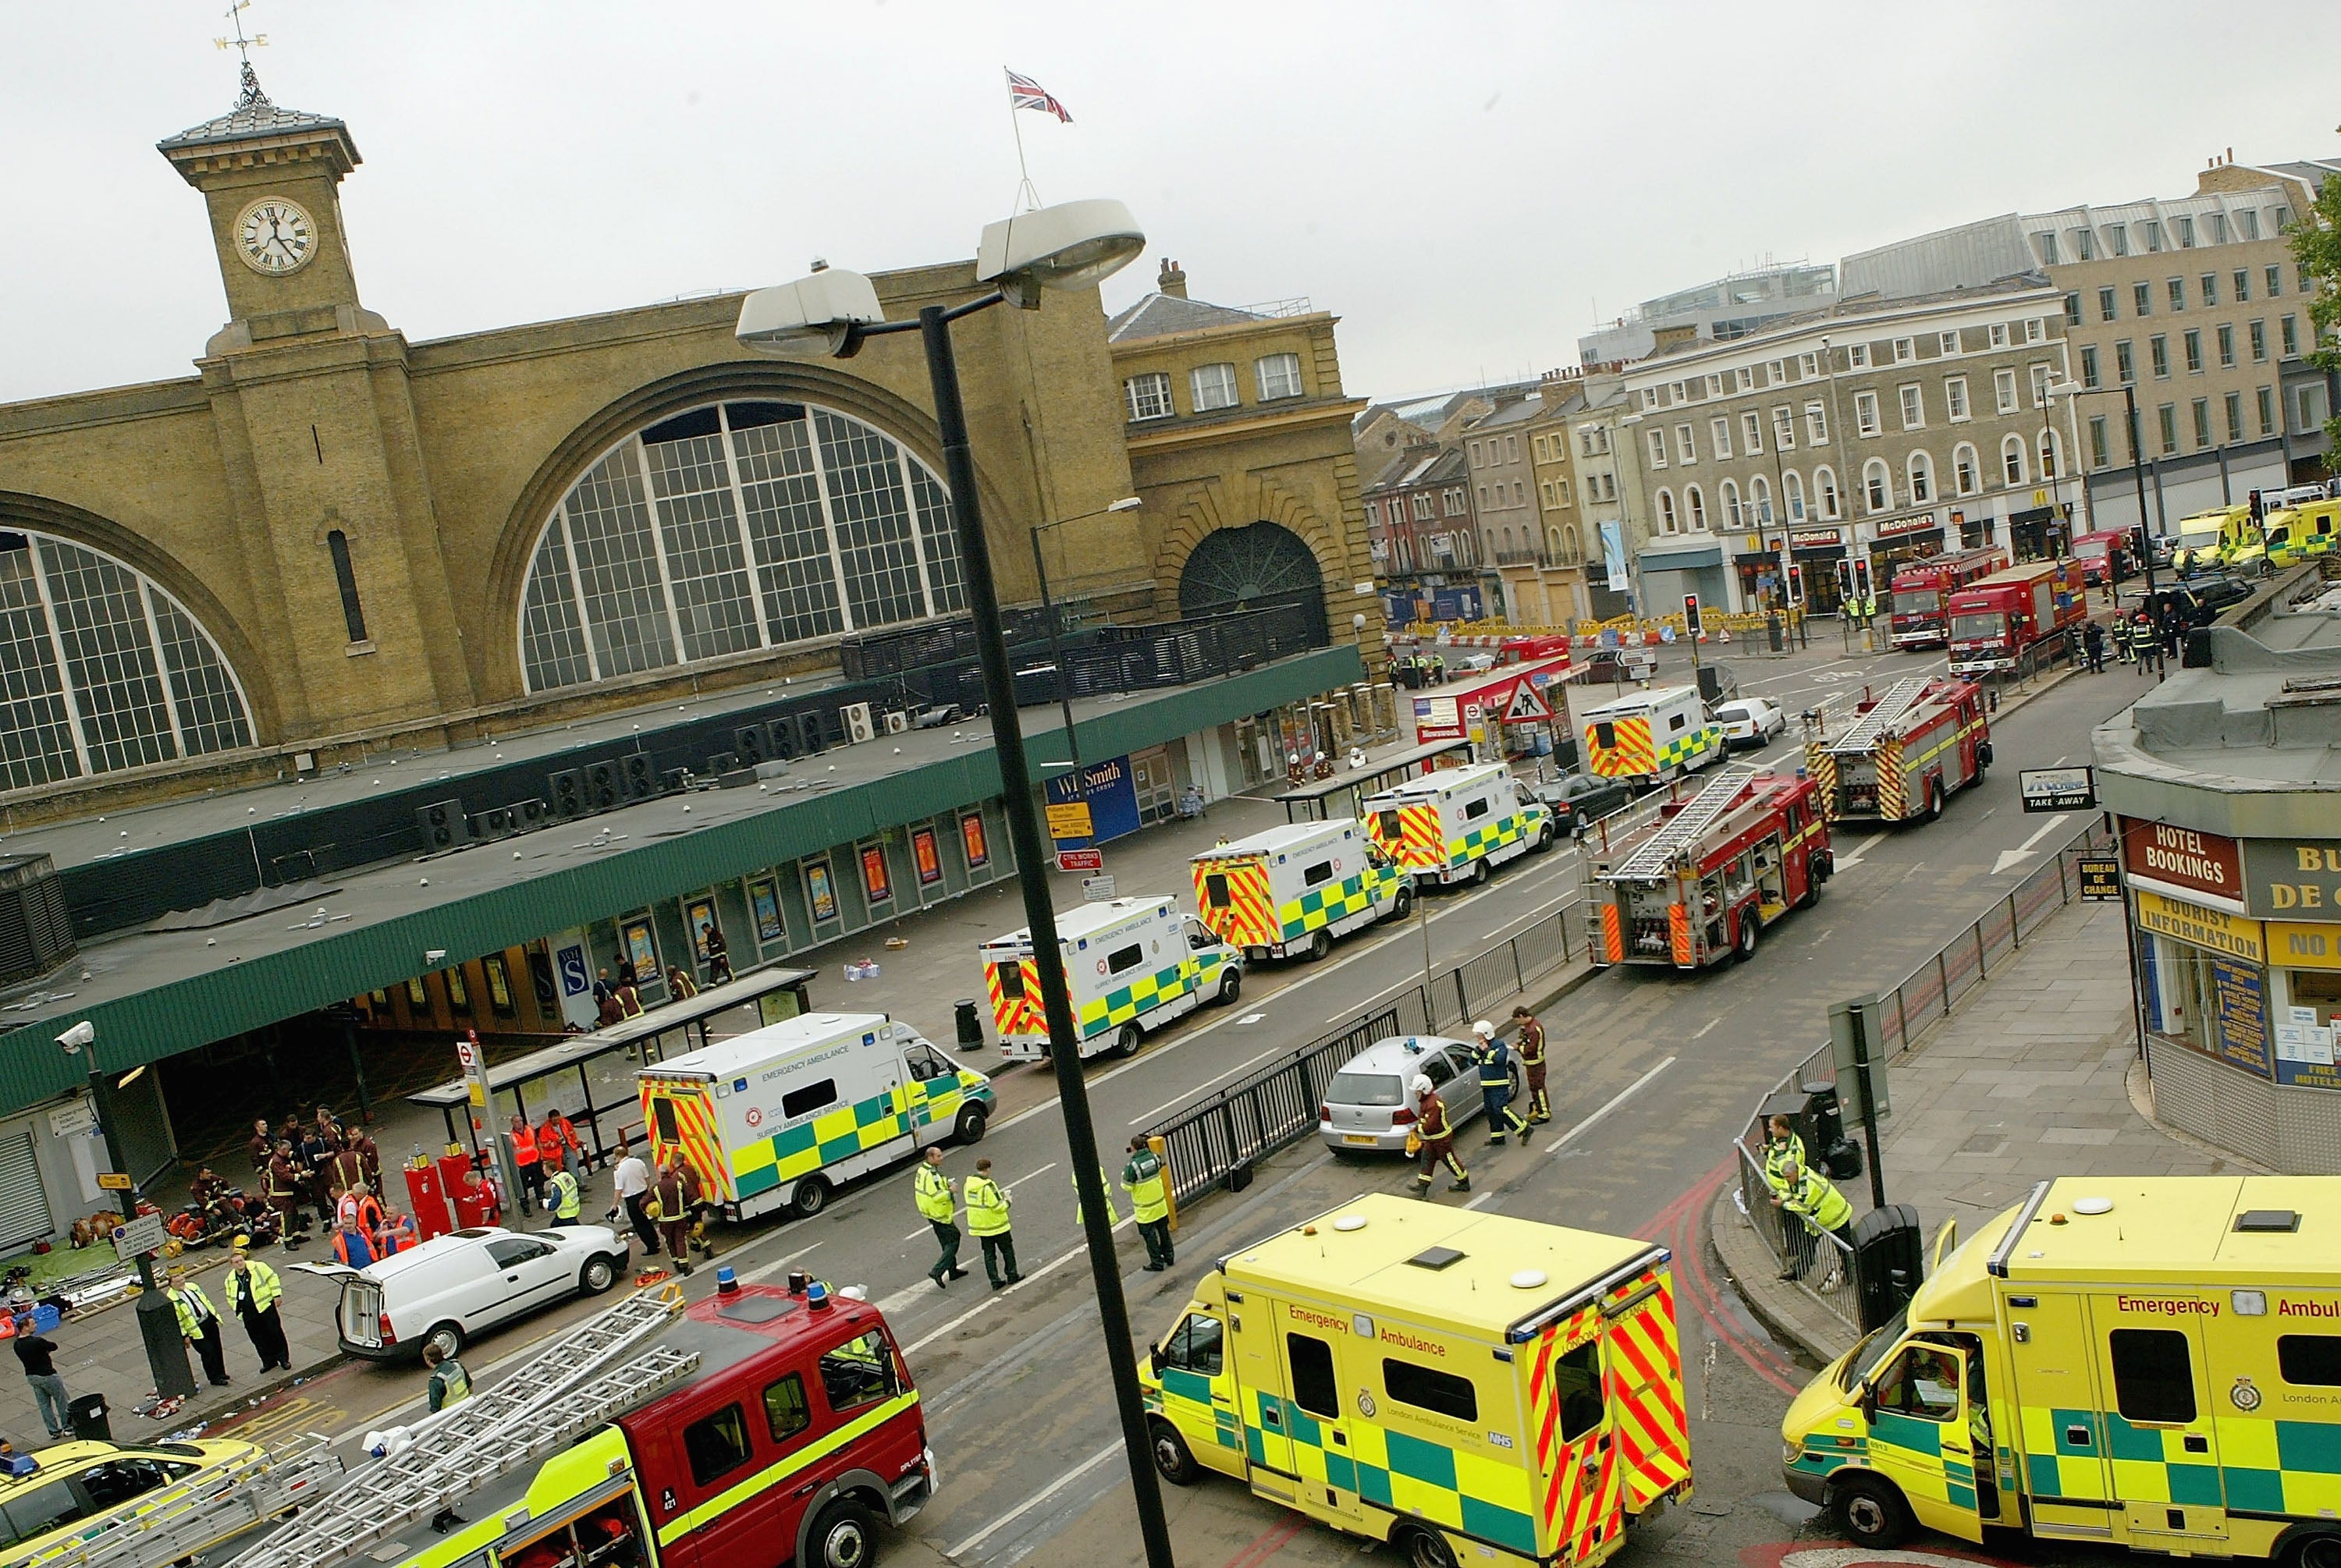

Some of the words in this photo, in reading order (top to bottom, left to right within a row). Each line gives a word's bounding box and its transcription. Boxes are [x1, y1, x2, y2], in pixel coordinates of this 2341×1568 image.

[1792, 530, 1837, 542] McDonald's
[1880, 515, 1933, 532] McDonald's
[2155, 825, 2206, 856] HOTEL
[2082, 864, 2115, 873] BUREAU
[2146, 846, 2224, 884] BOOKINGS
[2083, 885, 2118, 895] CHANGE
[2270, 883, 2321, 910] DE
[2158, 896, 2231, 929] TOURIST
[2144, 910, 2258, 959] INFORMATION
[2288, 932, 2325, 956] NO
[564, 960, 585, 993] S
[762, 1058, 805, 1082] EMERGENCY
[806, 1045, 850, 1066] AMBULANCE
[783, 1109, 822, 1130] AMBULANCE
[823, 1098, 850, 1114] SERVICE
[2118, 1295, 2220, 1318] Emergency
[1289, 1304, 1349, 1335] Emergency
[1380, 1327, 1446, 1357] Ambulance
[2282, 1393, 2327, 1404] London
[1387, 1407, 1413, 1421] London
[1414, 1414, 1454, 1432] Ambulance
[1455, 1424, 1481, 1440] Service
[1489, 1431, 1512, 1449] NHS
[664, 1498, 677, 1510] 421
[665, 1490, 671, 1500] A
